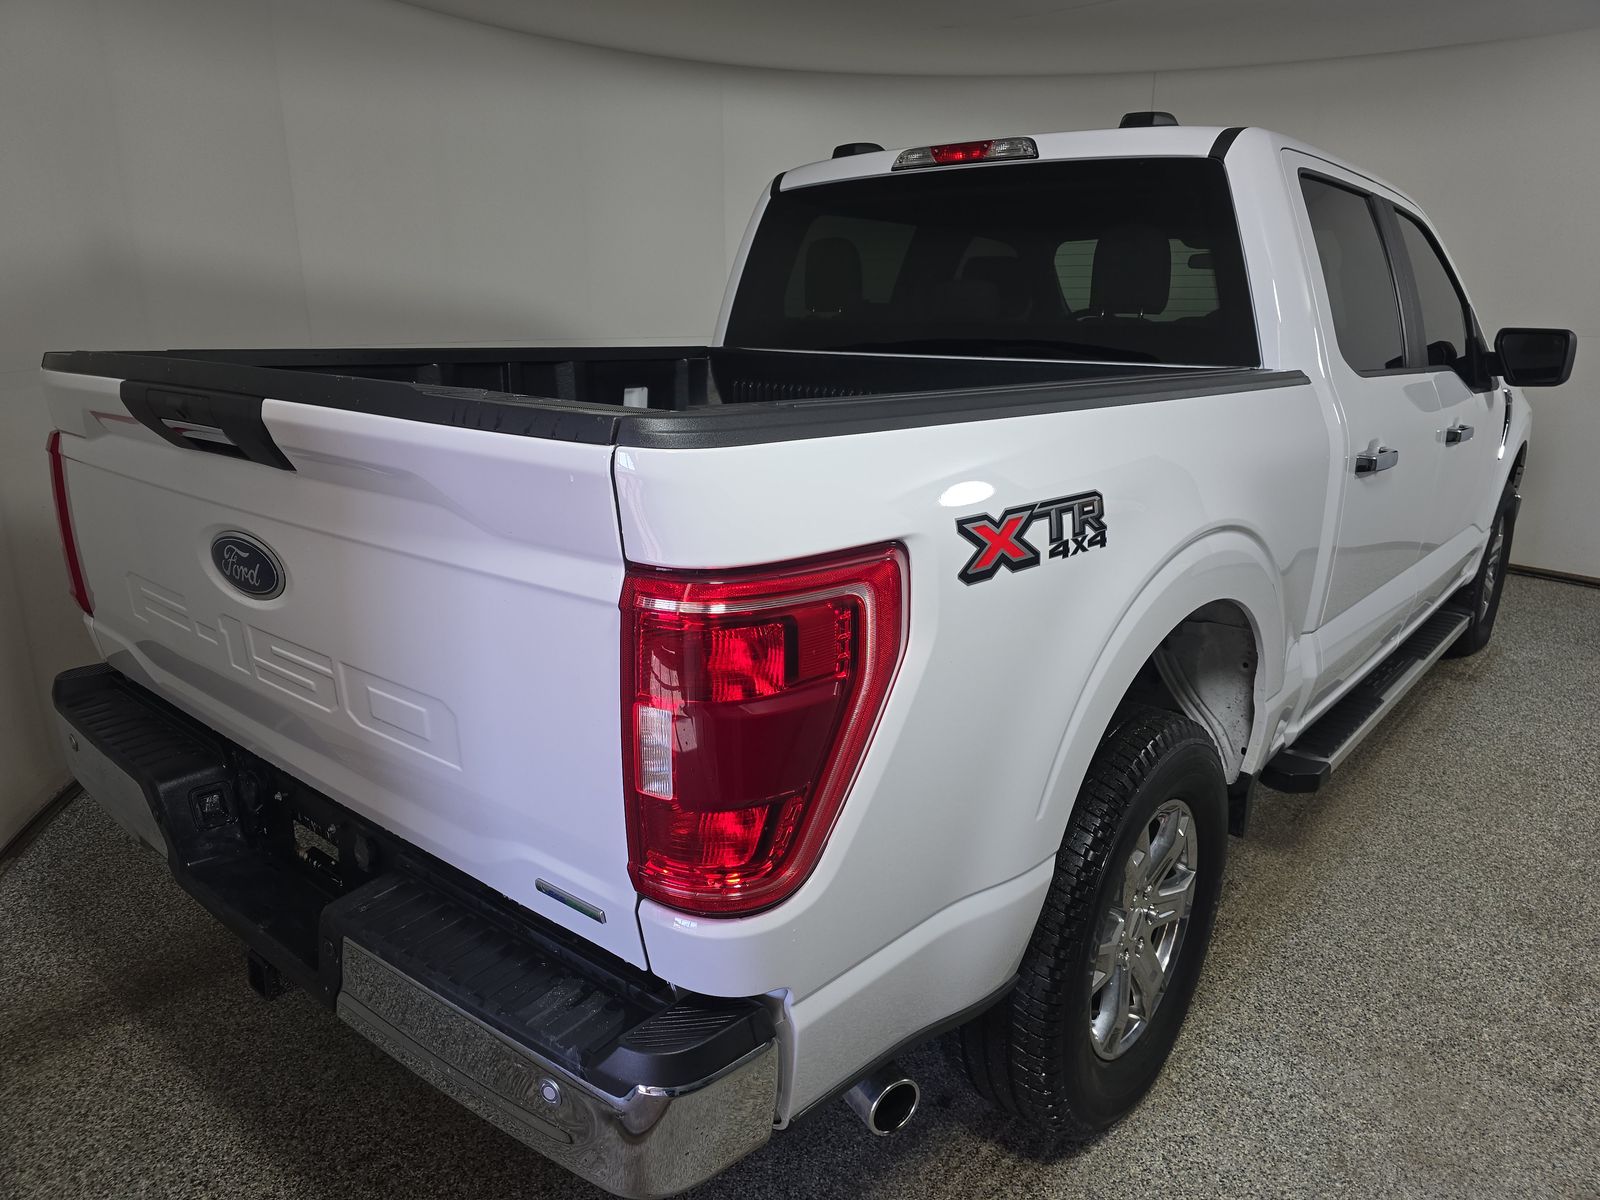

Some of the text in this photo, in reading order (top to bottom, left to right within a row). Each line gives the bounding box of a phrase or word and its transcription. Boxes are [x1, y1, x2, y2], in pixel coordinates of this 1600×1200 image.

[221, 544, 261, 586] Ford
[955, 489, 1108, 586] XTR
[125, 571, 463, 772] F-150
